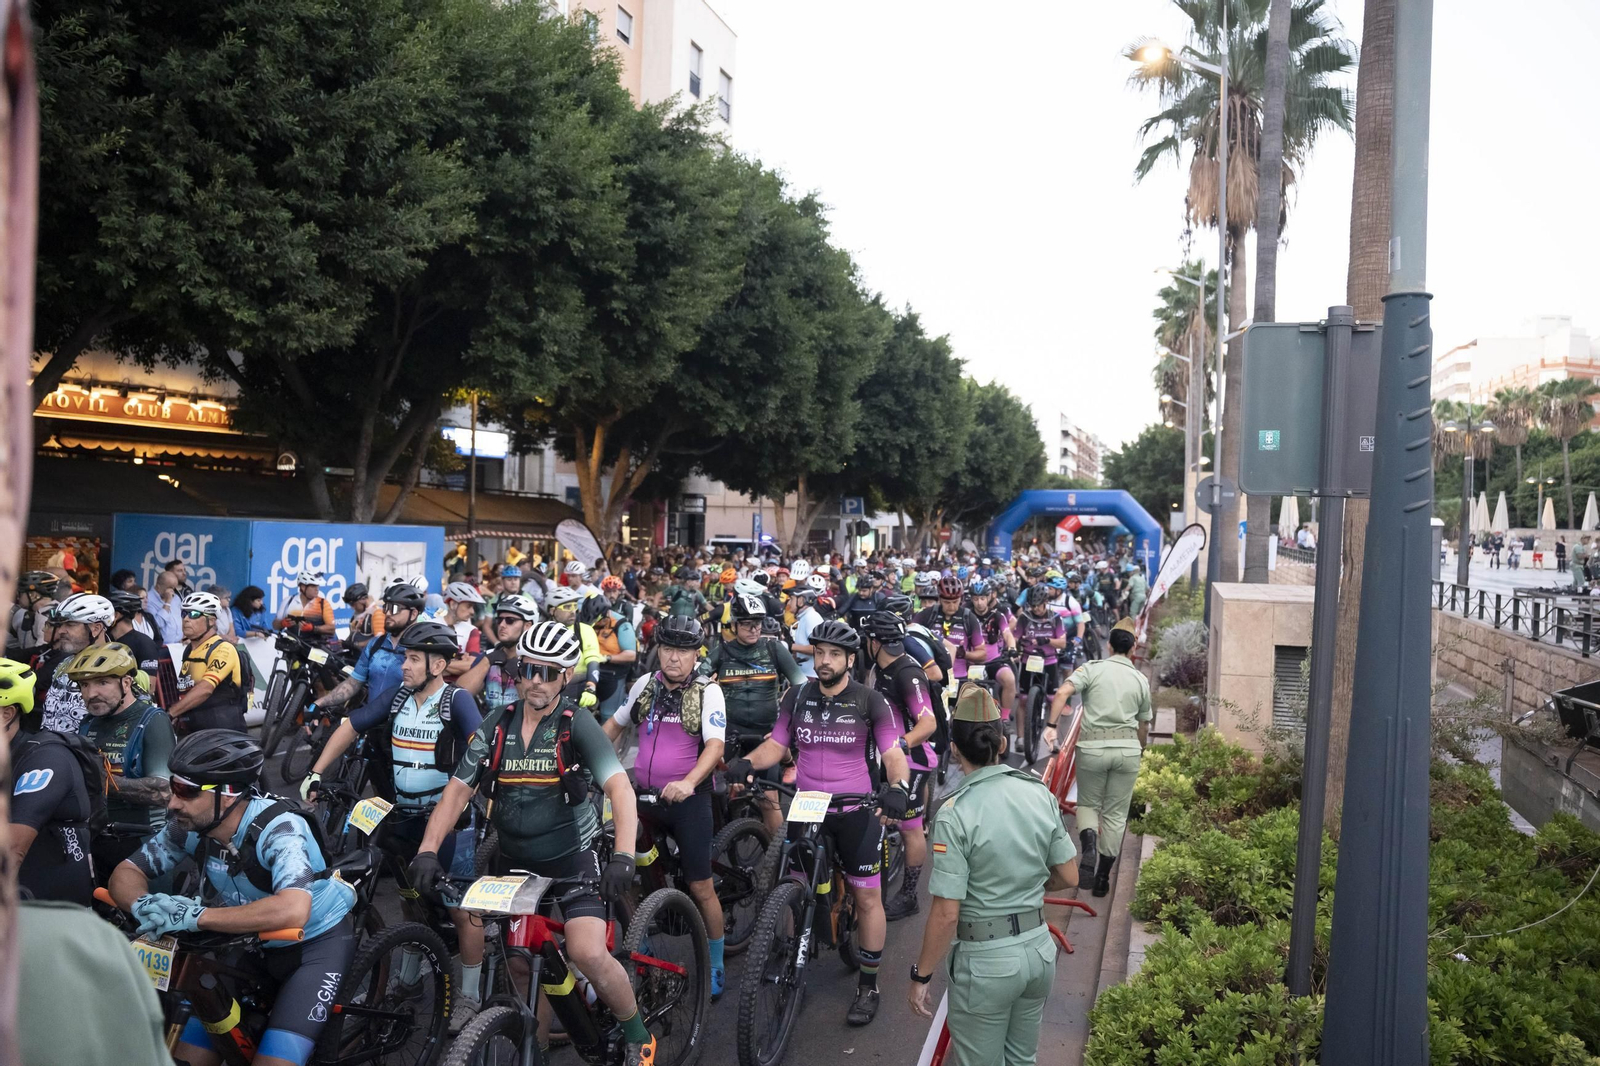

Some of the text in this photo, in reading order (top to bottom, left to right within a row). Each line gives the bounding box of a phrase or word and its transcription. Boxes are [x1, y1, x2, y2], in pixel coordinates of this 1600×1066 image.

[123, 402, 171, 419] CLUB
[186, 408, 234, 425] ALME
[845, 499, 858, 513] P
[155, 531, 213, 569] gar
[281, 537, 343, 577] gar
[813, 735, 857, 744] primaflor
[361, 804, 385, 823] 1005
[798, 800, 827, 812] 10022
[479, 883, 517, 895] 10021
[137, 948, 170, 972] 0139
[317, 972, 339, 1002] GMA
